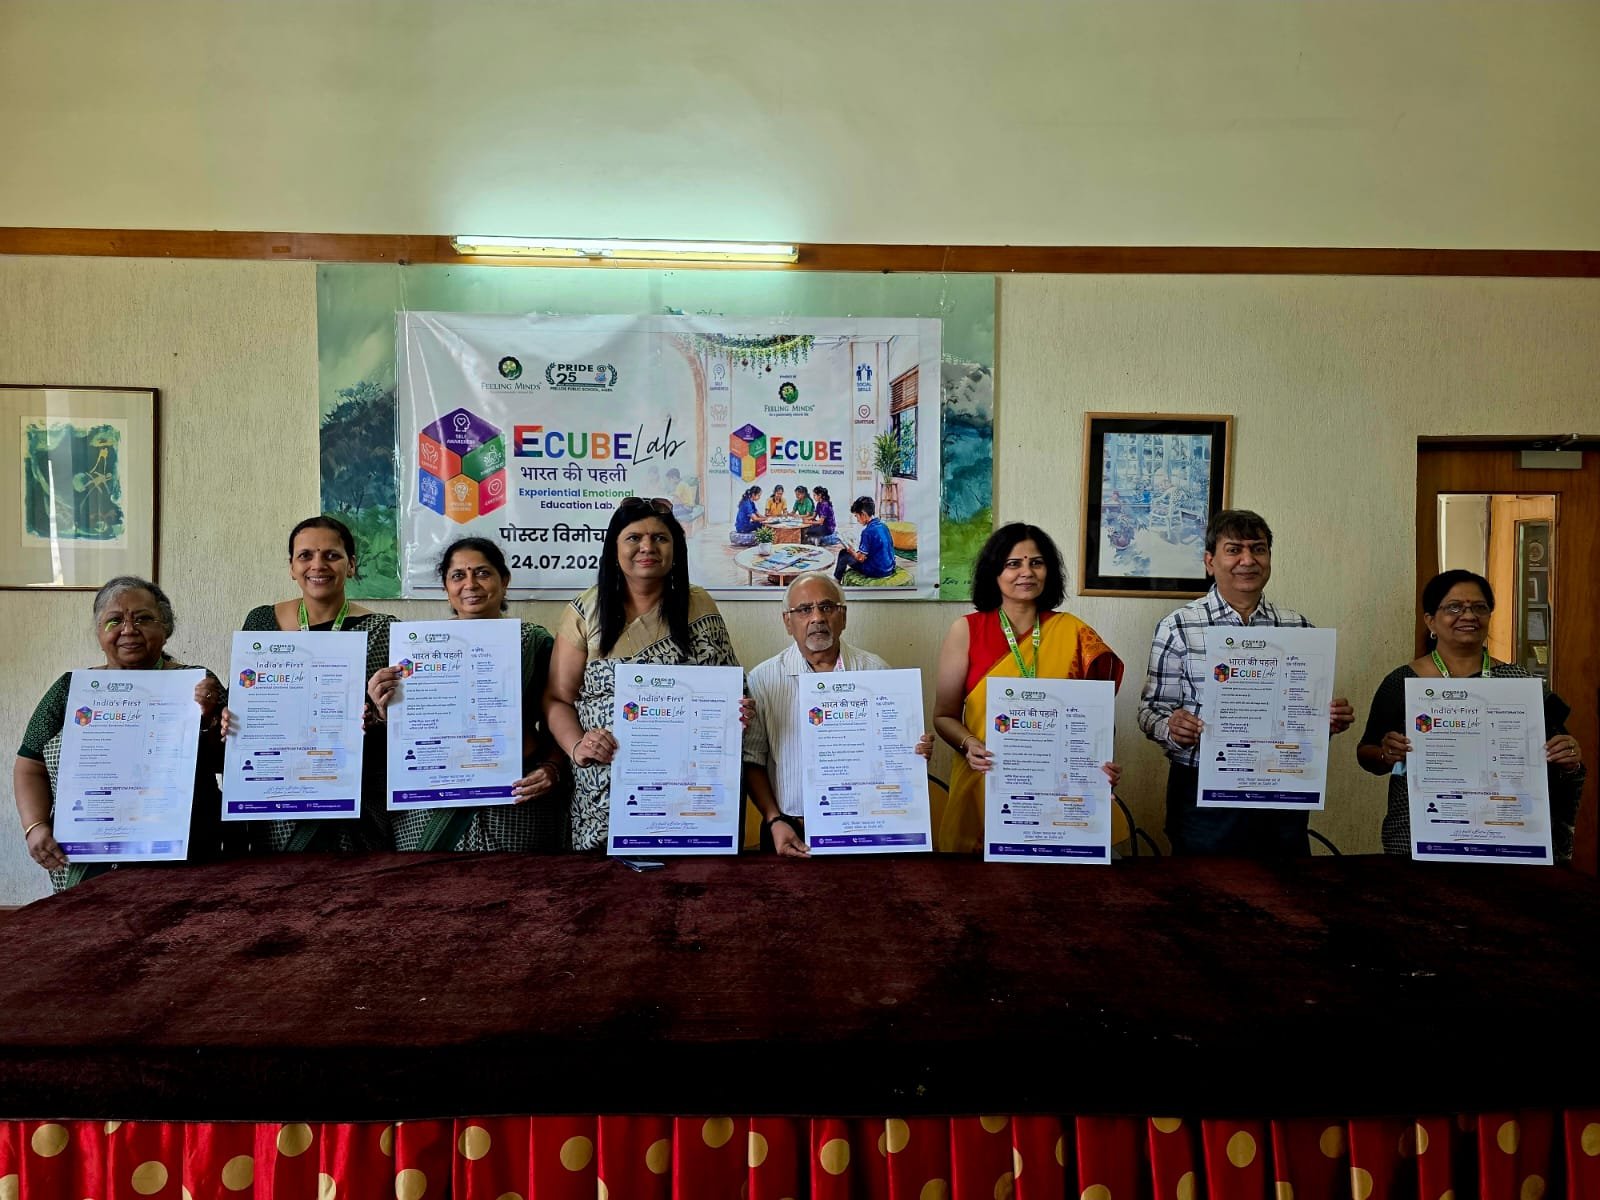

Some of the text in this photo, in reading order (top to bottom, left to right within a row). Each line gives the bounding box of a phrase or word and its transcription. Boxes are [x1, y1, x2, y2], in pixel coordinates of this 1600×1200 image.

[558, 364, 607, 373] PRIDE @
[556, 372, 577, 386] 25
[514, 417, 686, 465] ECUBE Lab
[770, 437, 842, 460] ECUBE
[521, 462, 627, 484] भारत की पहली
[519, 488, 634, 498] Experiential Emotional
[541, 501, 616, 510] Education Lab.
[499, 523, 608, 542] पोस्टर विमोच
[123, 699, 141, 707] First
[667, 695, 684, 703] First
